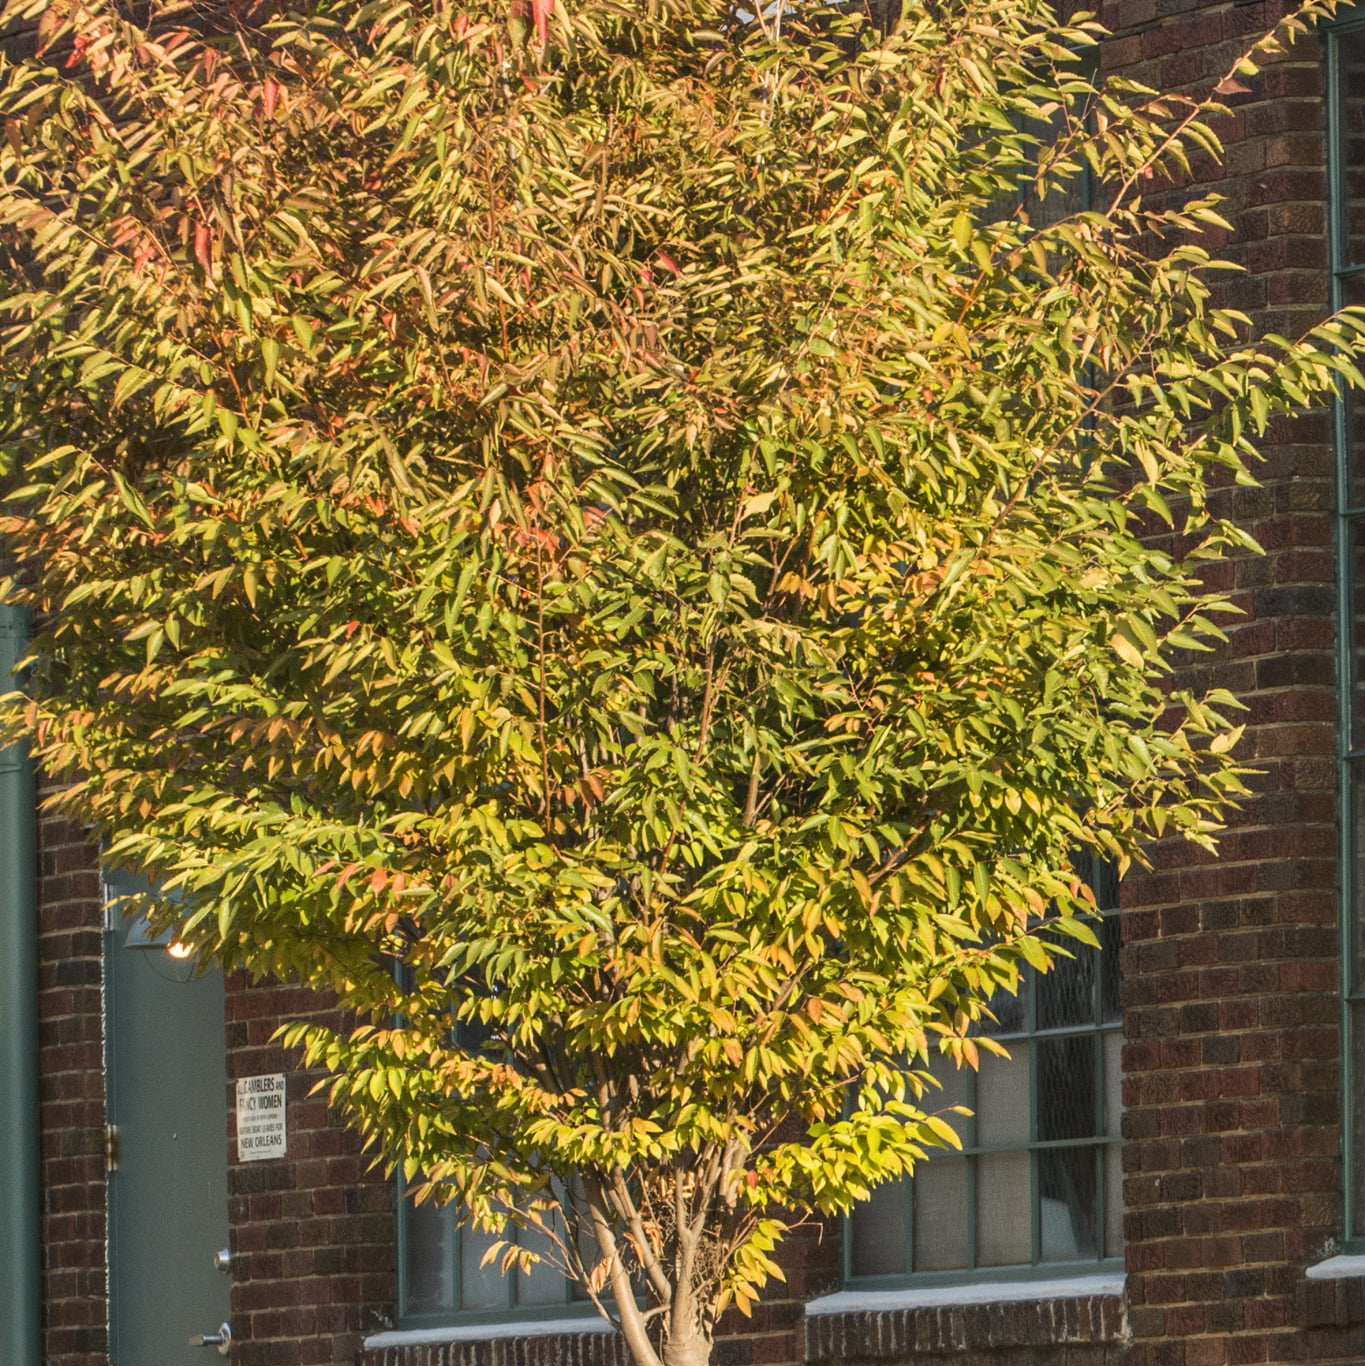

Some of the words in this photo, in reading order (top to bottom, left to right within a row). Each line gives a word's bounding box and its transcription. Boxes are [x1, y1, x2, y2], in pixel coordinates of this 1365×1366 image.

[257, 1094, 282, 1109] WOMEN
[240, 1137, 254, 1149] NEW
[255, 1133, 282, 1148] ORLEANS
